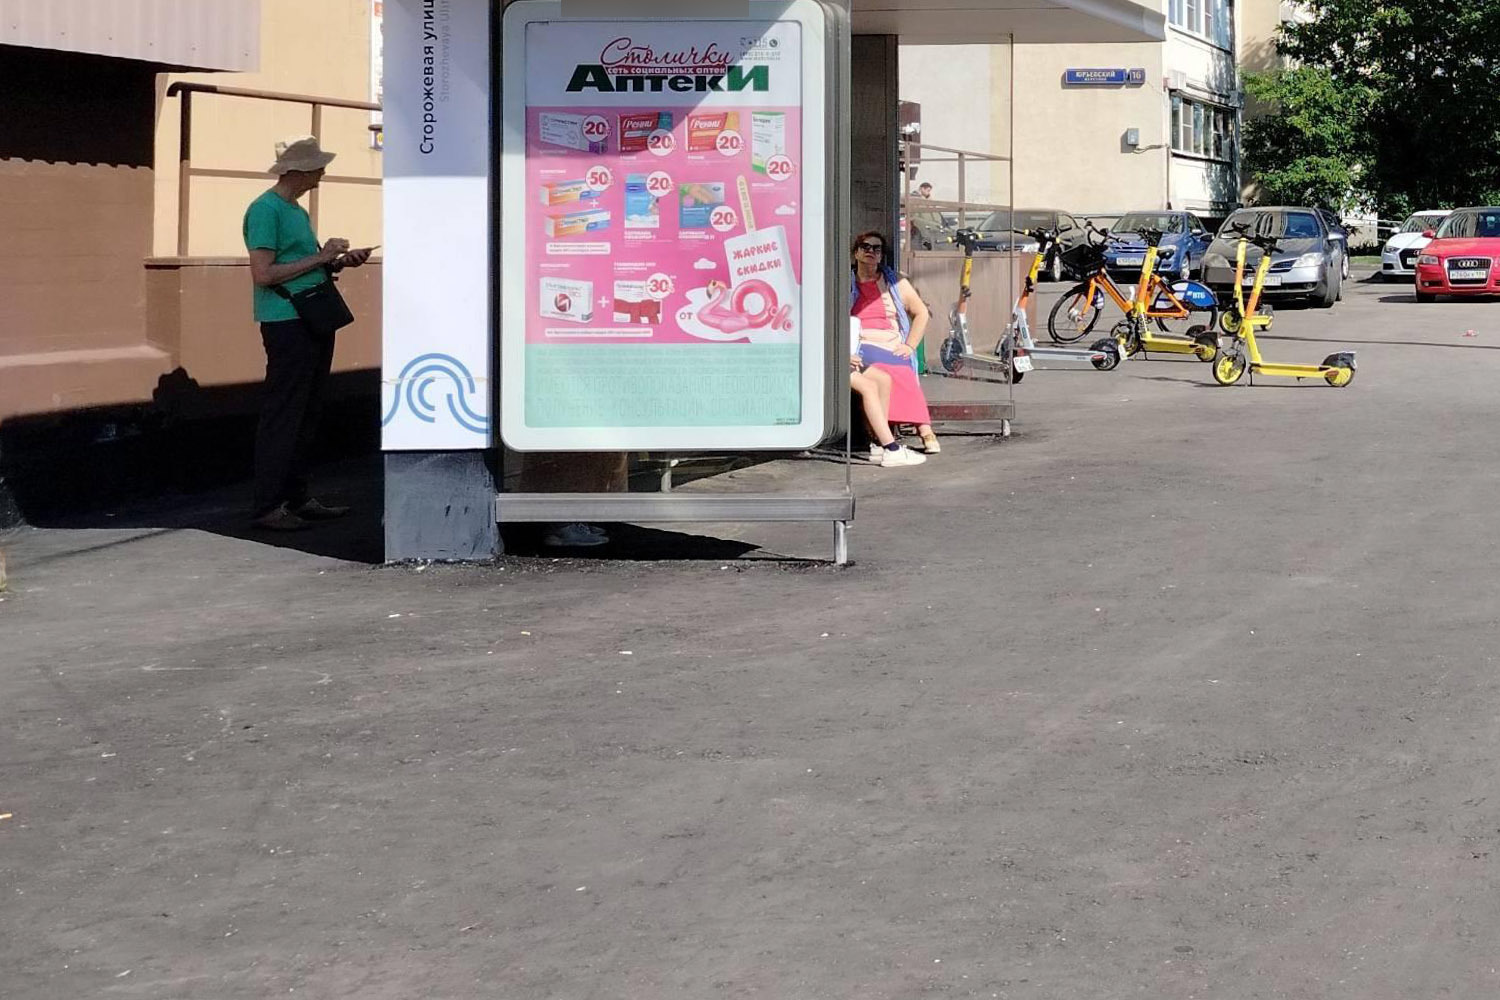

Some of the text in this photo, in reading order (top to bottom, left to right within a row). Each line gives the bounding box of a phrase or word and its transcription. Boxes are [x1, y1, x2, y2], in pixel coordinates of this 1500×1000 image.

[601, 37, 734, 66] Столички
[439, 24, 451, 103] Storozhevaya
[607, 66, 726, 75] сеть социальных аптек
[1132, 71, 1142, 79] 16
[420, 45, 437, 154] Сторожевая
[732, 241, 779, 260] ЖАРКИЕ
[736, 259, 782, 277] СКИДКИ
